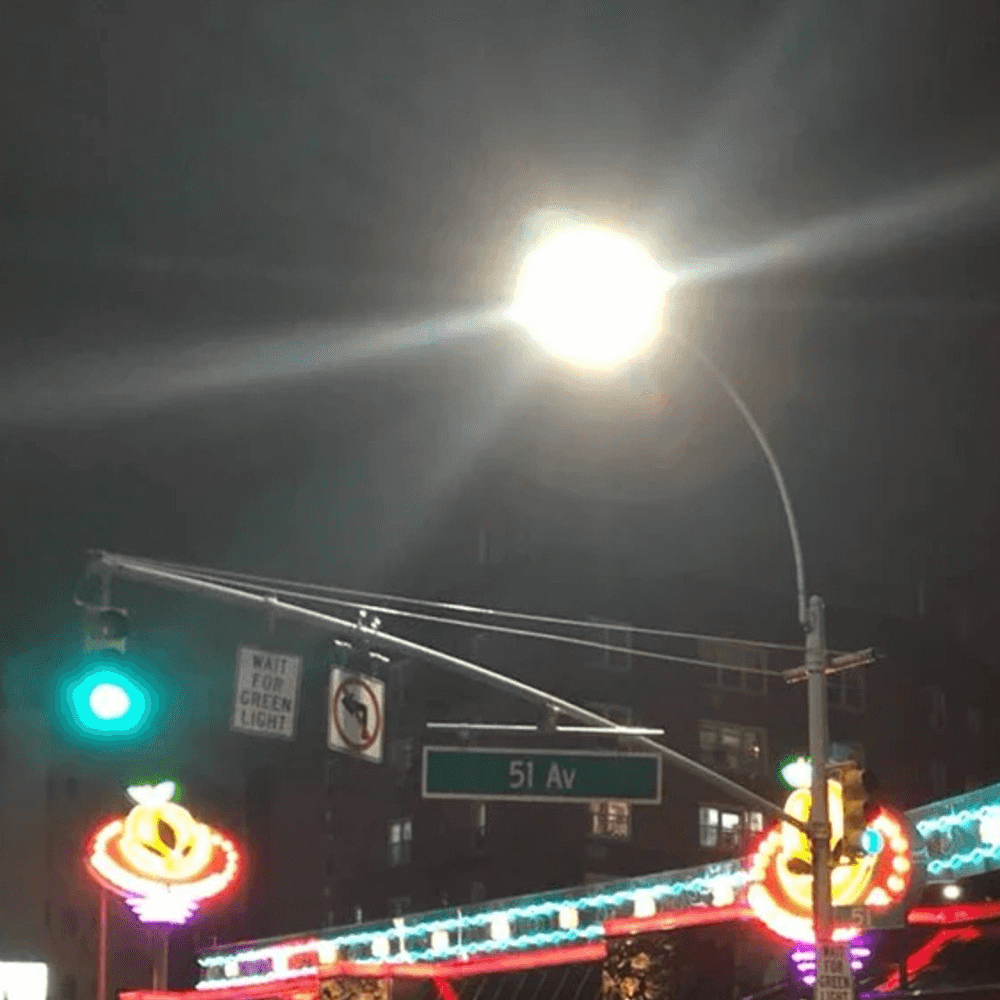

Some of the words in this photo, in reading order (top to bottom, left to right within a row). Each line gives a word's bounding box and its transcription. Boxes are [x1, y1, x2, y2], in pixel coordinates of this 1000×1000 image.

[252, 654, 287, 673] WAIT
[252, 673, 284, 692] FOR
[240, 690, 292, 712] GREEN
[241, 711, 286, 731] LIGHT
[509, 760, 534, 788] 51
[546, 763, 576, 789] Av
